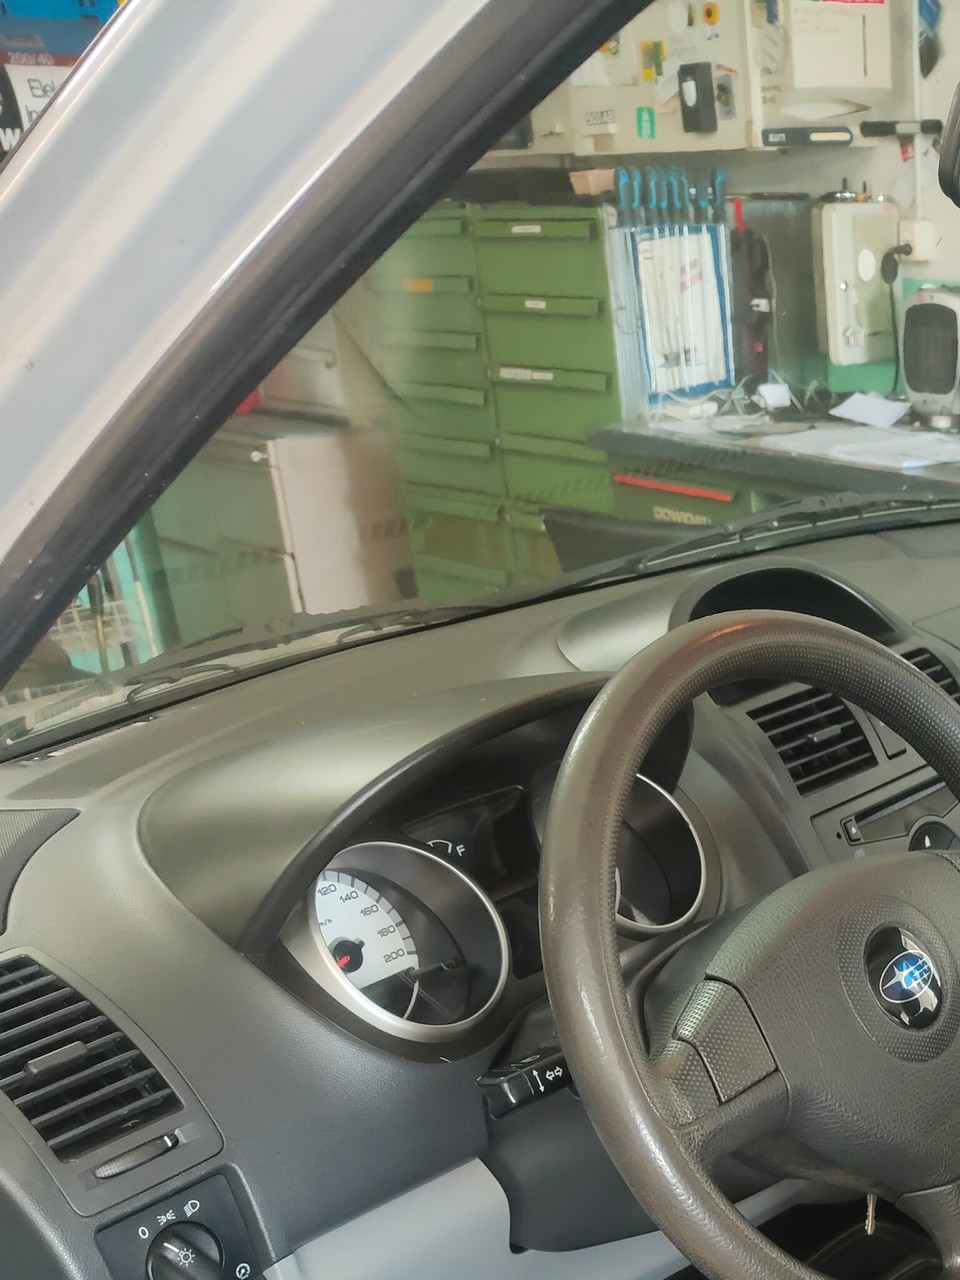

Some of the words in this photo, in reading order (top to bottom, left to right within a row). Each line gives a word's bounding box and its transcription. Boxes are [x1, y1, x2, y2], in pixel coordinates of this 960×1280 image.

[456, 844, 466, 857] F
[317, 883, 337, 897] 120
[339, 890, 359, 904] 140
[360, 903, 379, 917] 160
[319, 918, 333, 928] m/h
[377, 924, 396, 938] 180
[383, 948, 406, 964] 200
